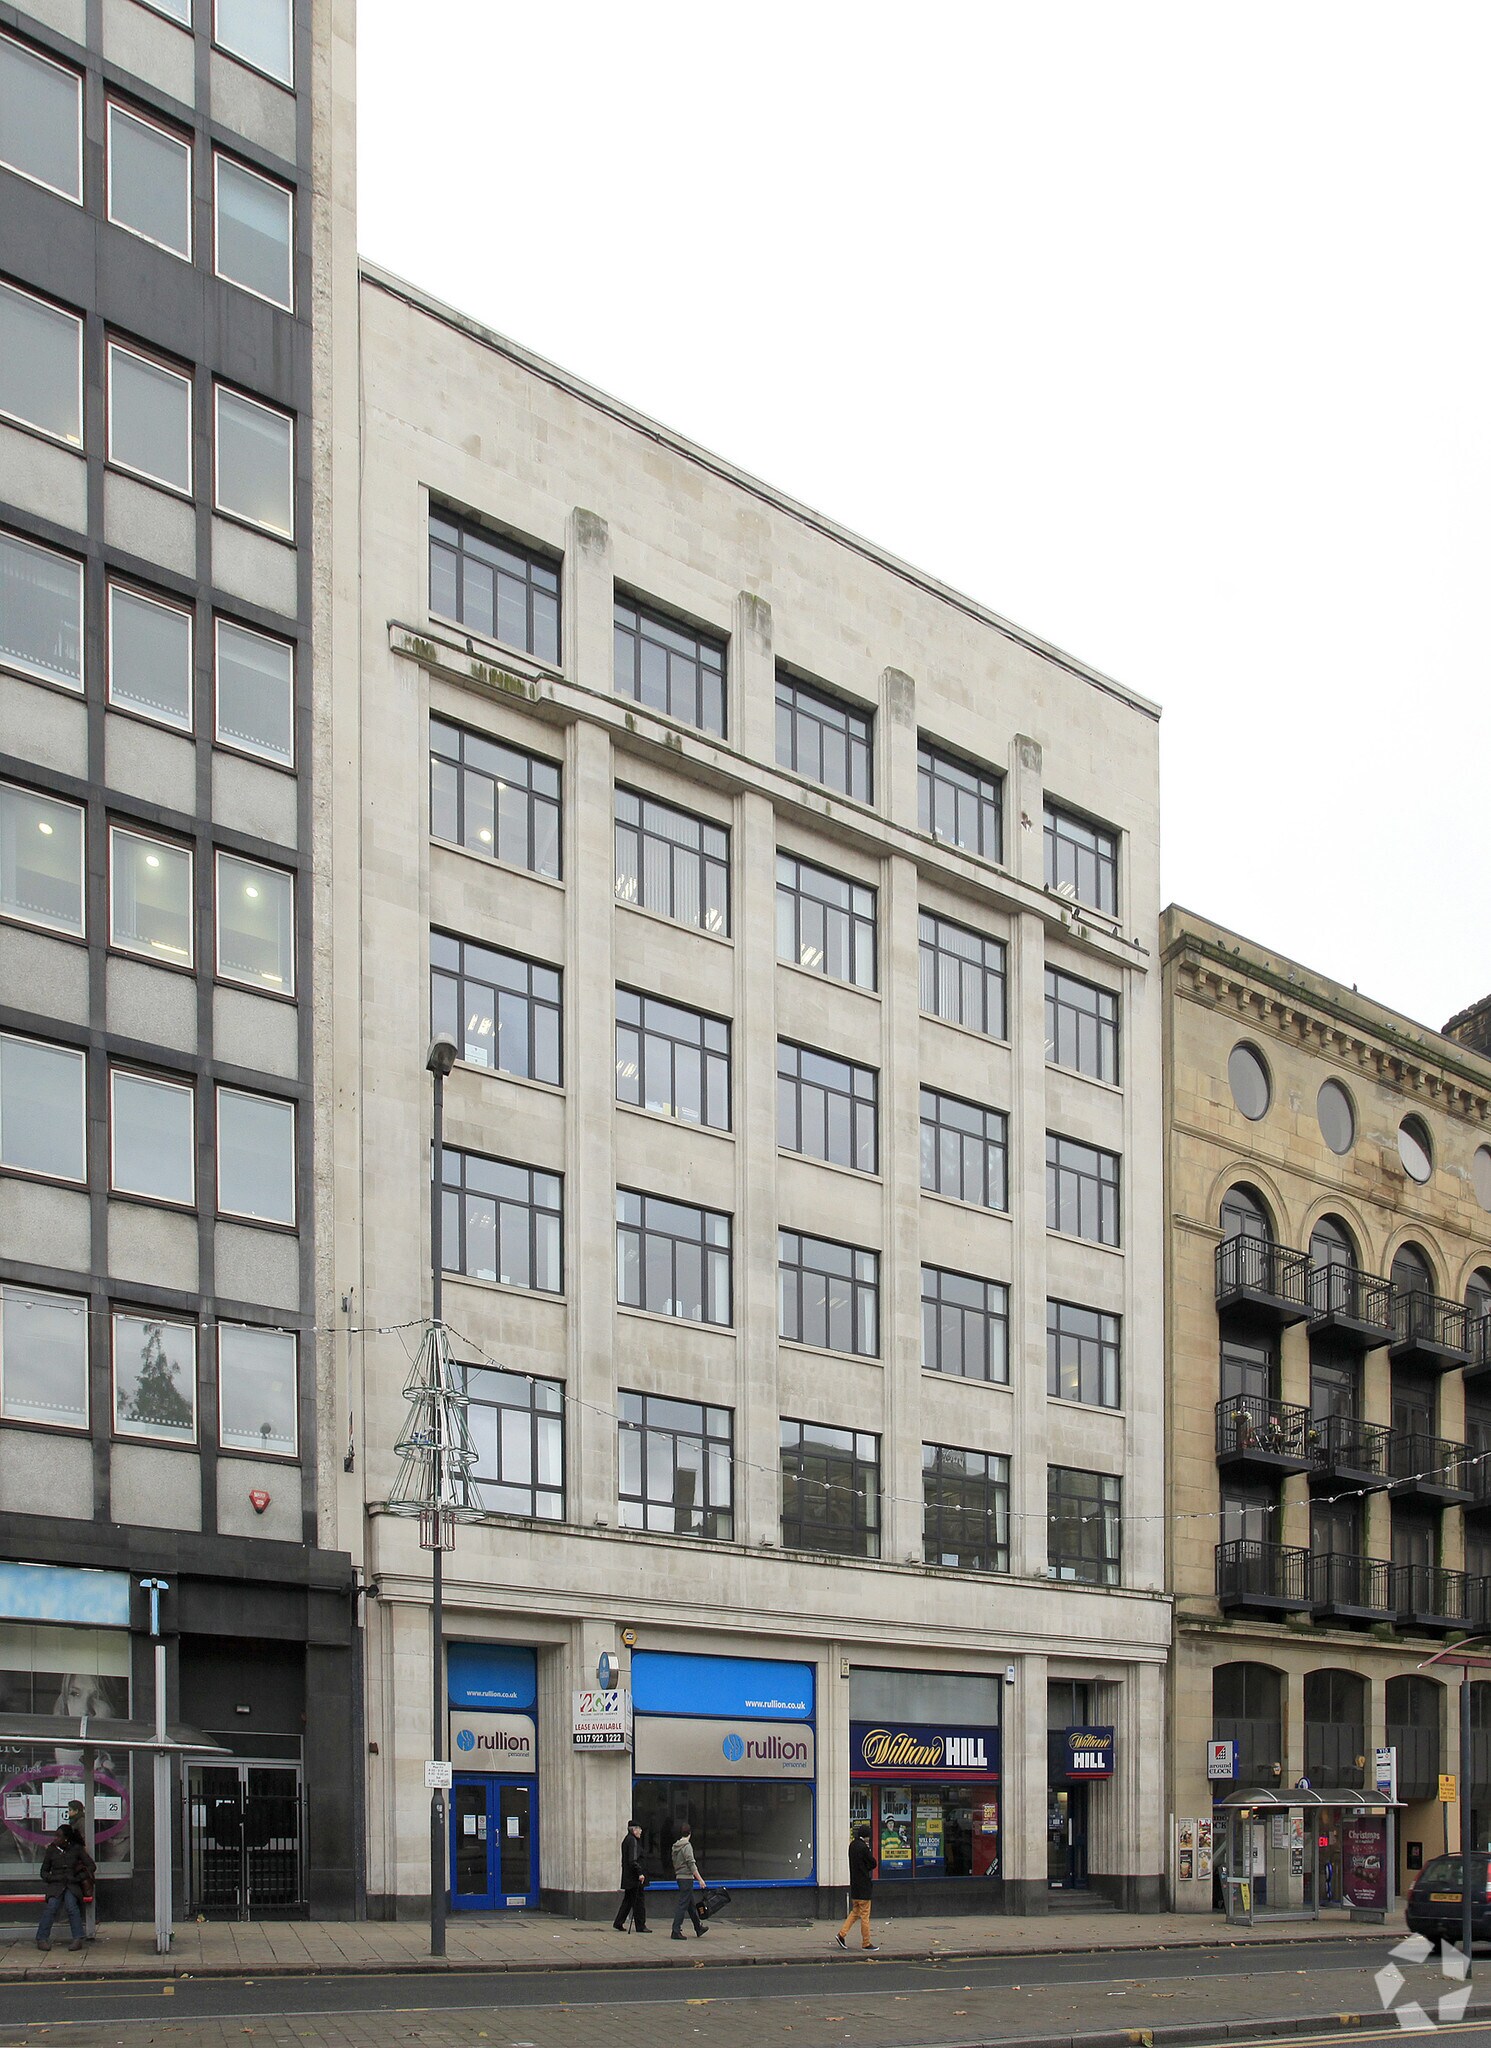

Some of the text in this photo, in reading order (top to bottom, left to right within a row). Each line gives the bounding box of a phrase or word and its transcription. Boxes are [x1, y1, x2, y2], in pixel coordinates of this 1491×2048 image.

[466, 1690, 518, 1699] www.rullion.co.uk
[745, 1699, 806, 1710] www.rullion.co.uk
[575, 1722, 622, 1731] LEASE AVAILABLE
[477, 1731, 530, 1751] rullion
[575, 1733, 621, 1743] 0117 922 1222
[1068, 1732, 1111, 1750] William
[746, 1735, 807, 1760] rullion
[862, 1729, 988, 1767] William HILL
[1073, 1752, 1106, 1769] HILL
[0, 1764, 42, 1774] Help desk
[109, 1803, 118, 1812] 25
[883, 1802, 908, 1815] JUMPS
[1348, 1830, 1380, 1840] Christmas
